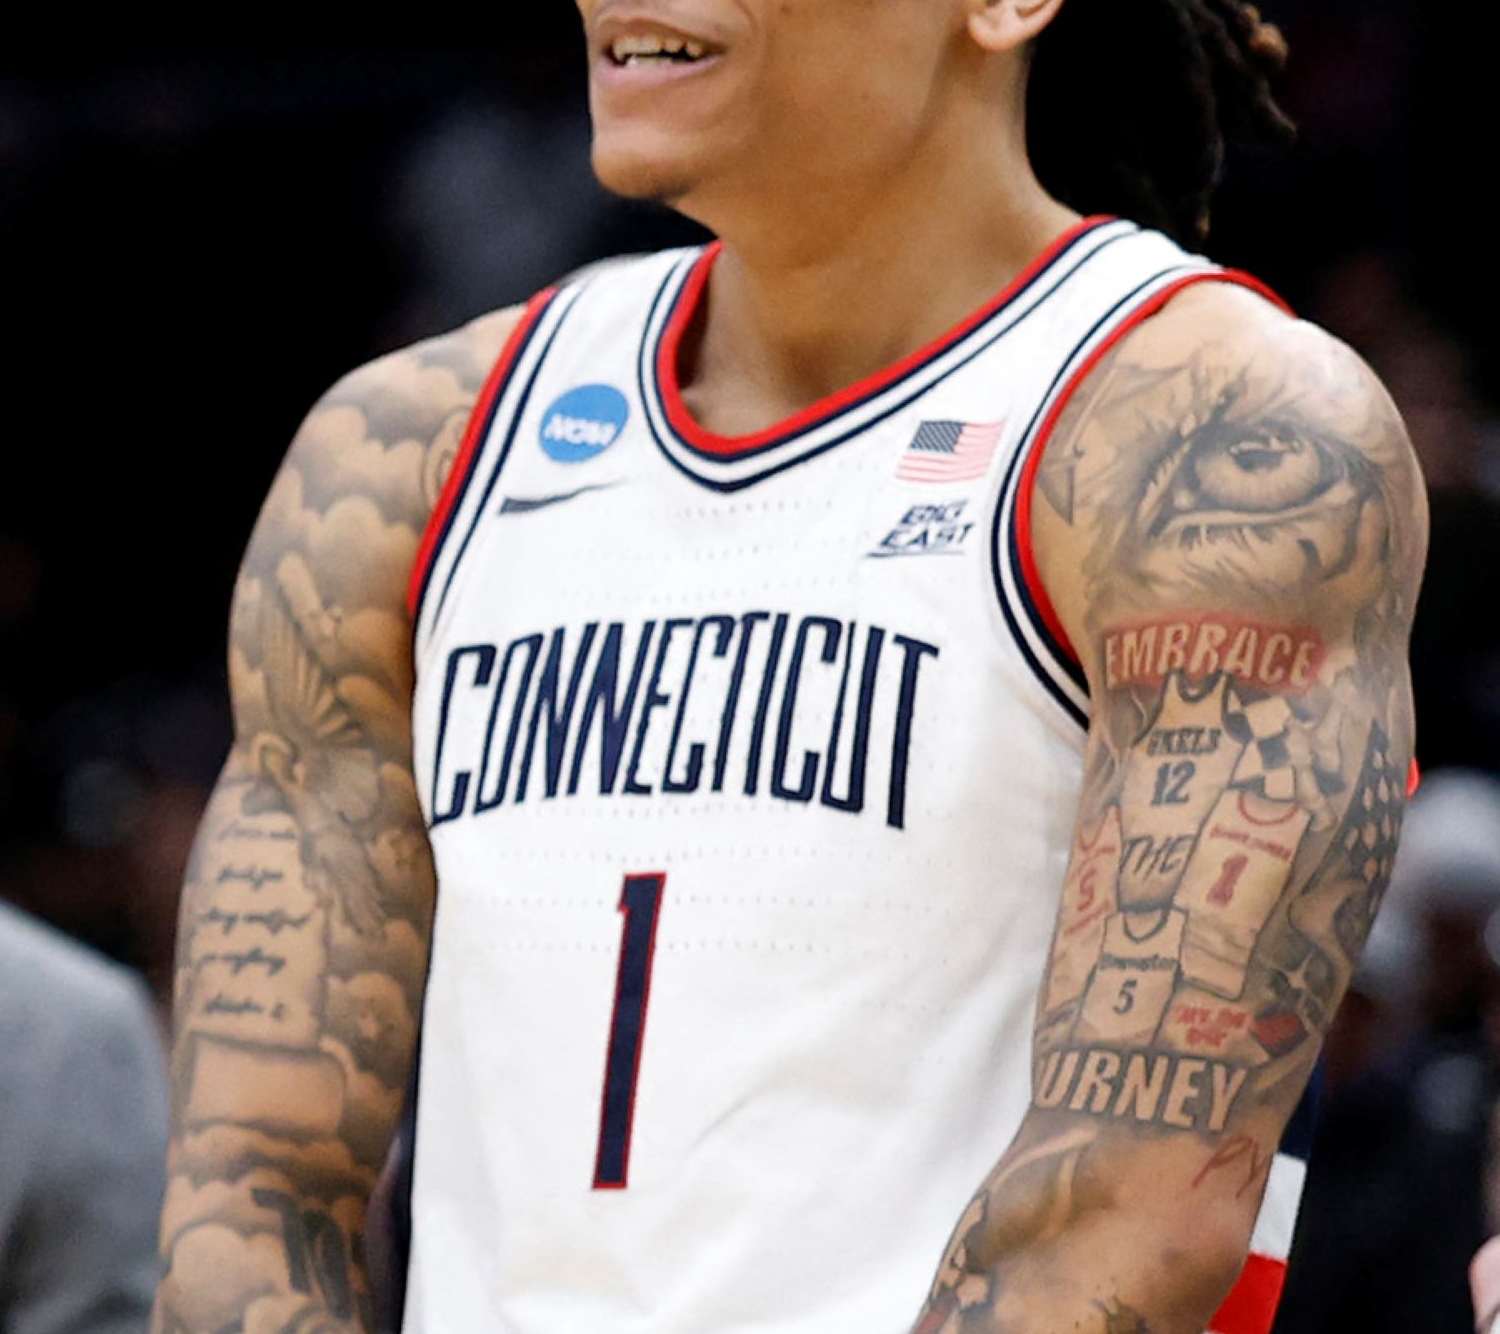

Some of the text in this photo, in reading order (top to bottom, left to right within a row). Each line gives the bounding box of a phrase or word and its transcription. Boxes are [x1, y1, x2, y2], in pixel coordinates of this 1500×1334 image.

[543, 413, 617, 447] NCAA
[1104, 622, 1318, 690] EMBRACE
[428, 610, 940, 830] CONNECTICUT
[1152, 760, 1197, 806] 12
[1112, 978, 1139, 1016] 5
[591, 872, 668, 1191] 1
